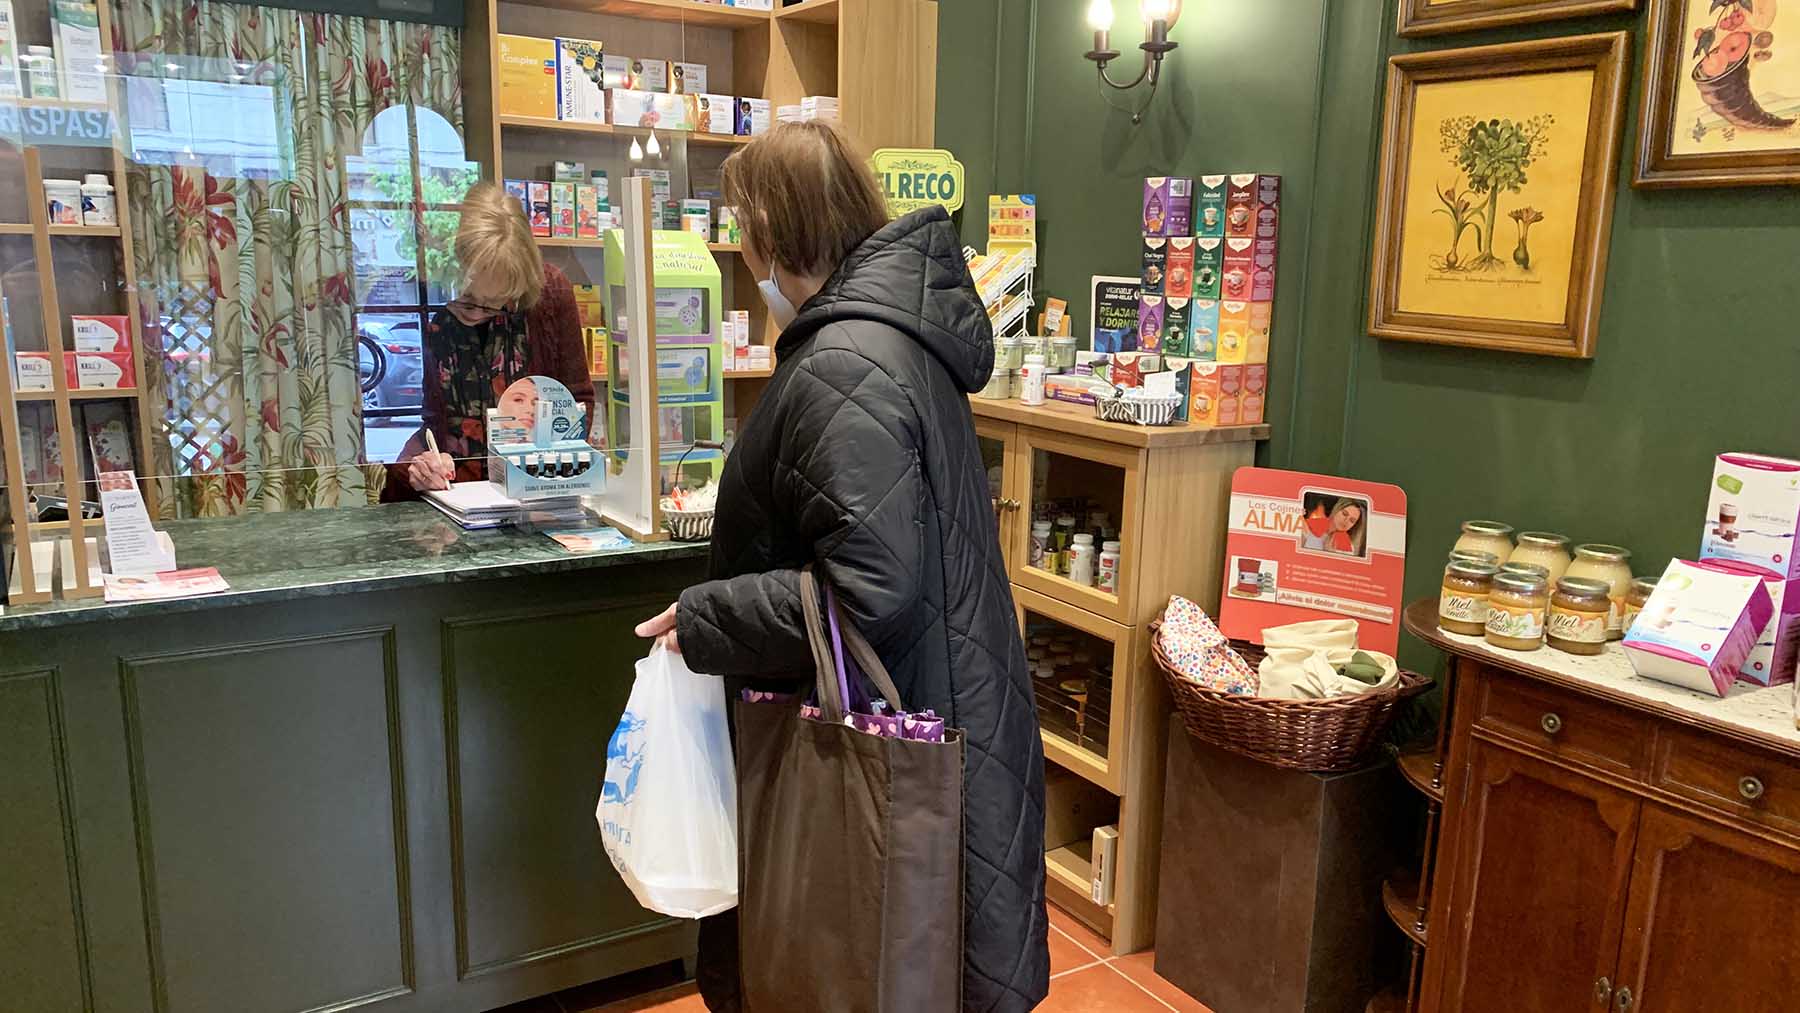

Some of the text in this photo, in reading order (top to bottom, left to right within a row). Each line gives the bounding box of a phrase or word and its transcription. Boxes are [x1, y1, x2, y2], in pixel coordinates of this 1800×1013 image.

[1100, 306, 1141, 319] RELAJARS
[1244, 509, 1310, 534] ALMA
[1449, 597, 1472, 609] Miel
[1554, 615, 1578, 628] Miel
